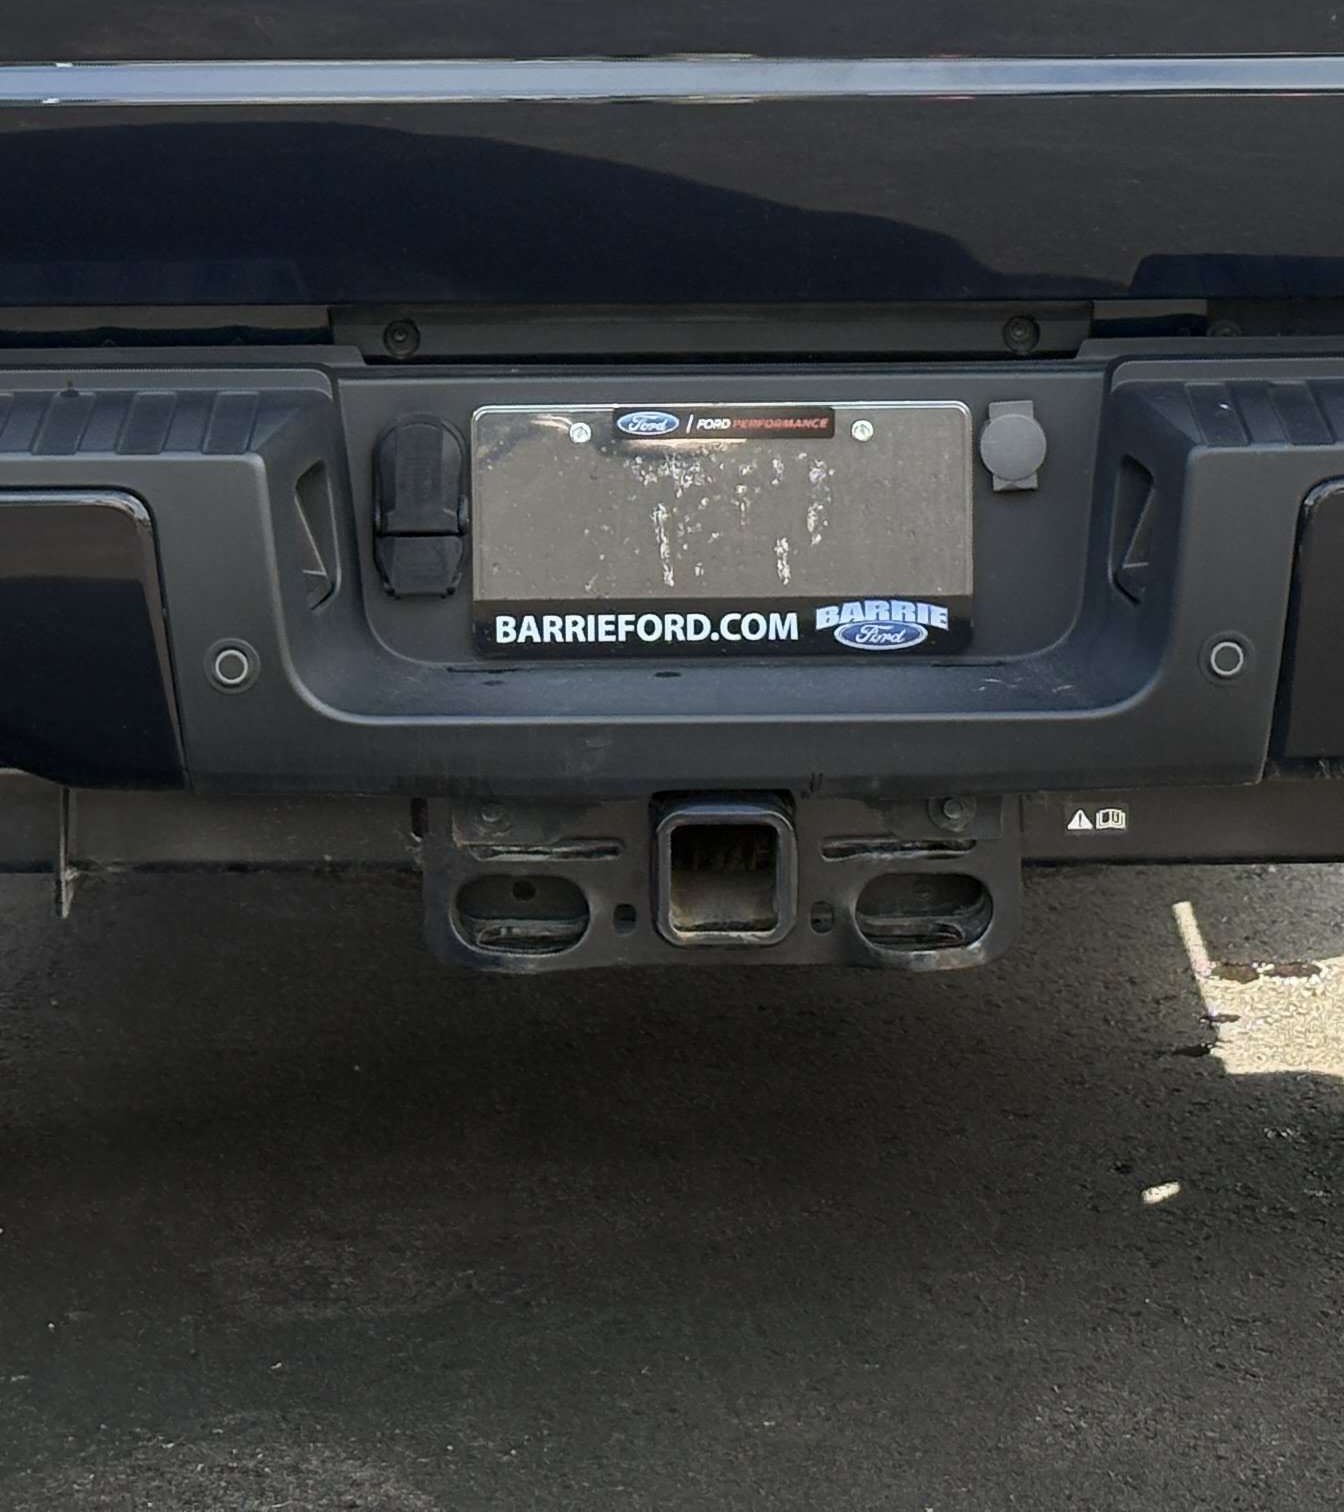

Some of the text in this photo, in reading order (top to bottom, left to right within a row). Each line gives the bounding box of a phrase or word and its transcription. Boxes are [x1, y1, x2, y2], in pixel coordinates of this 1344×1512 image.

[628, 415, 668, 431] Ford
[696, 418, 829, 430] FORD PERFORMANCE
[815, 600, 949, 631] BARRIE
[495, 613, 799, 644] BARRIEFORD.COM
[855, 620, 907, 643] Ford
